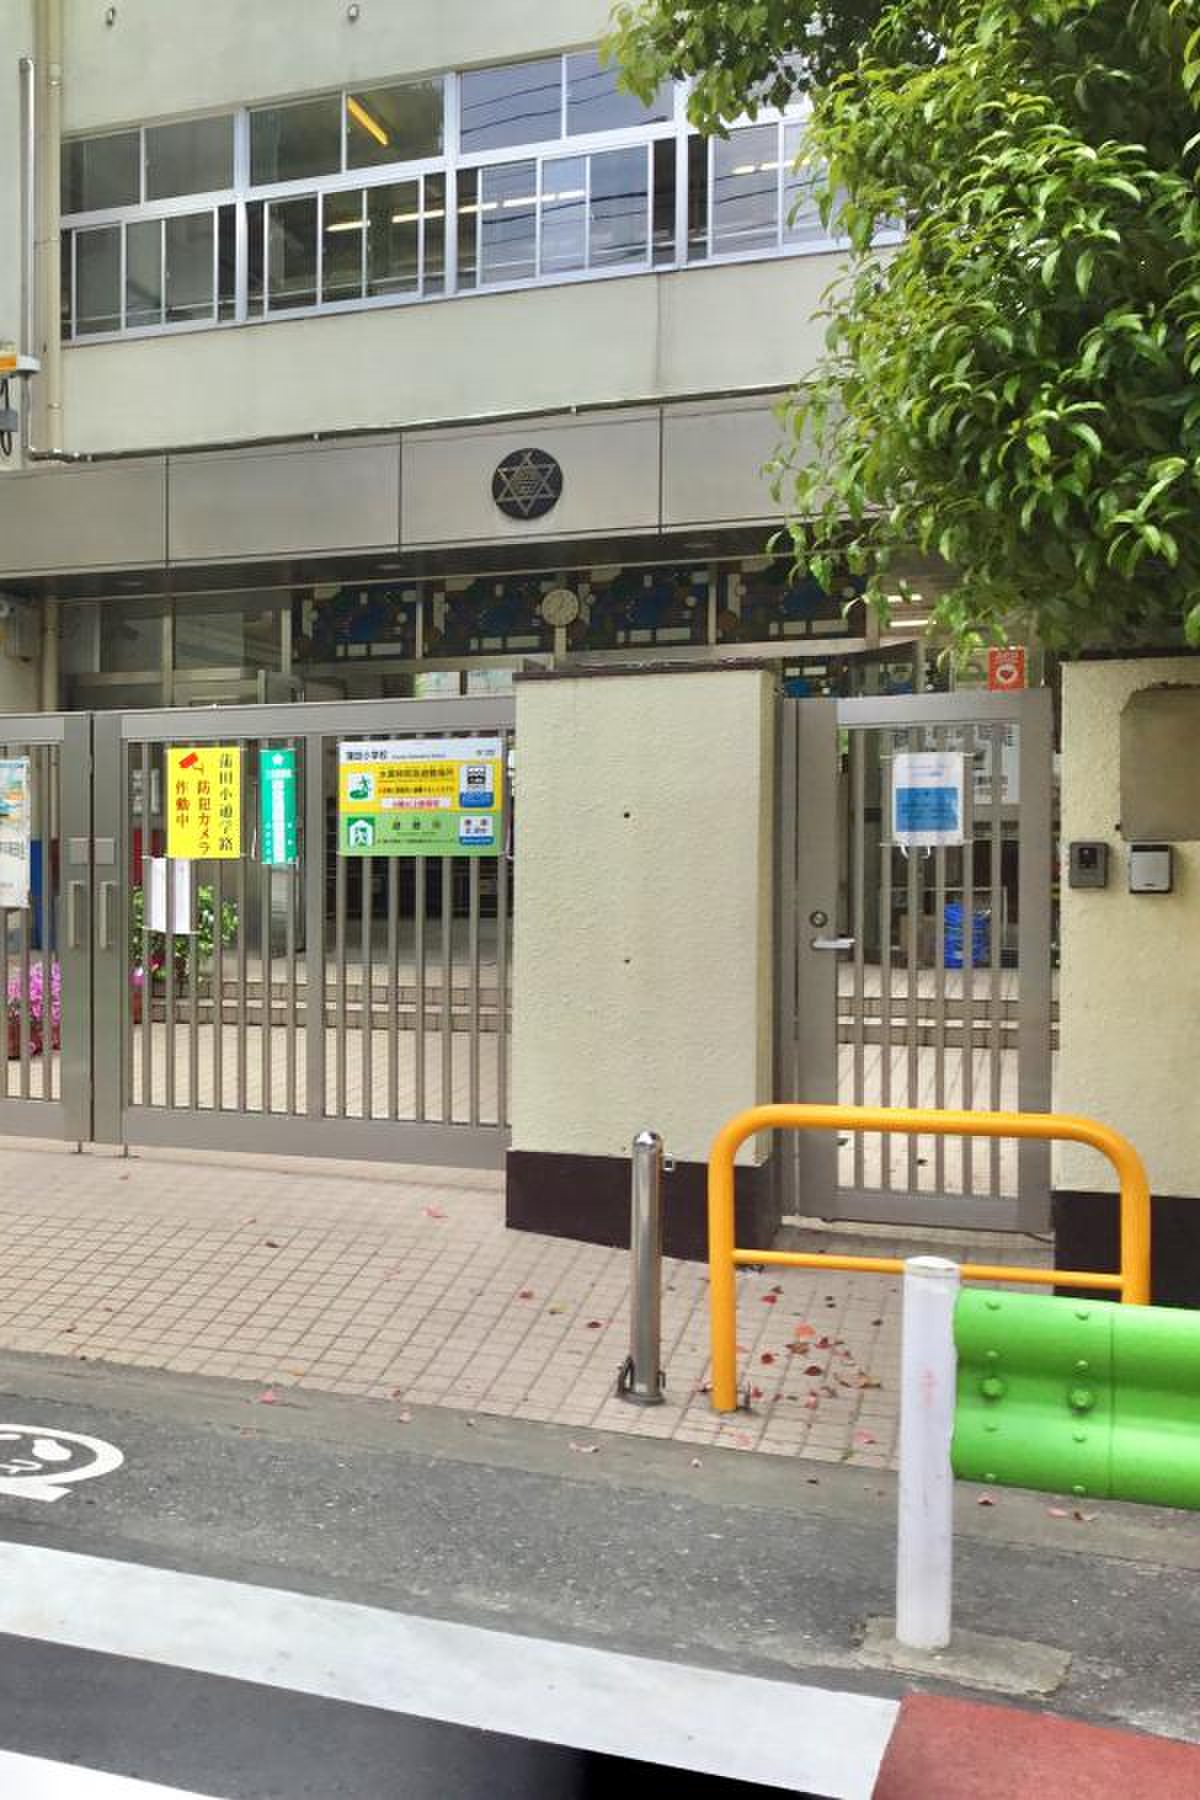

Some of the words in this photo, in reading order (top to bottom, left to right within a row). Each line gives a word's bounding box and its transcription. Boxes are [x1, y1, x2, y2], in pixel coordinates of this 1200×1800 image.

[175, 780, 191, 829] 作動中
[197, 779, 211, 856] 防犯カメラ
